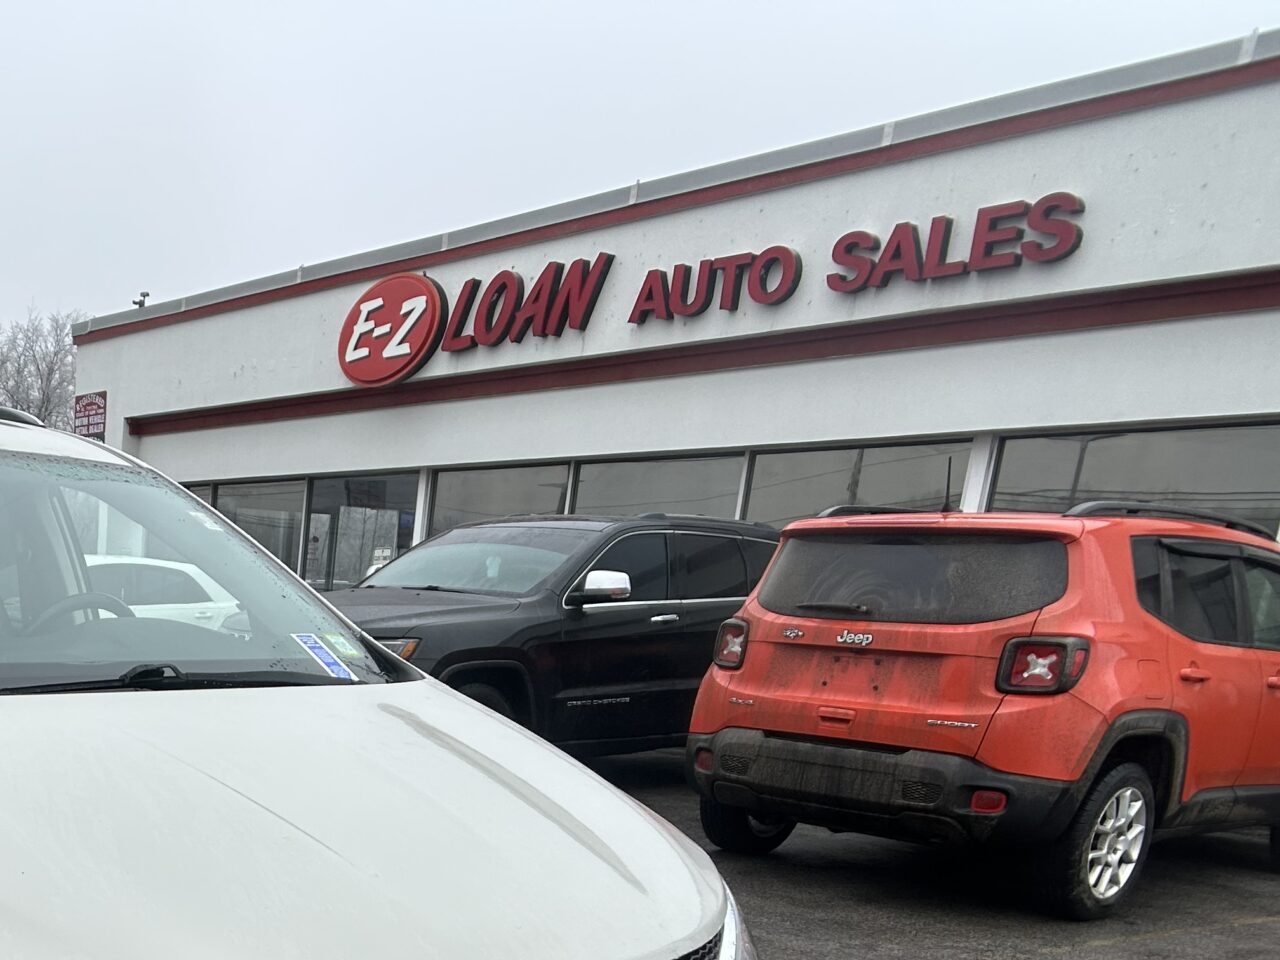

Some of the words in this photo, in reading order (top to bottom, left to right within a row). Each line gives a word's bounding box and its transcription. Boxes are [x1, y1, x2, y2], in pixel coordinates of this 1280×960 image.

[345, 296, 427, 362] E-Z
[441, 252, 615, 352] LOAN
[627, 245, 803, 324] AUTO
[826, 191, 1086, 293] SALES
[836, 629, 873, 646] Jeep
[927, 719, 979, 728] SPORT
